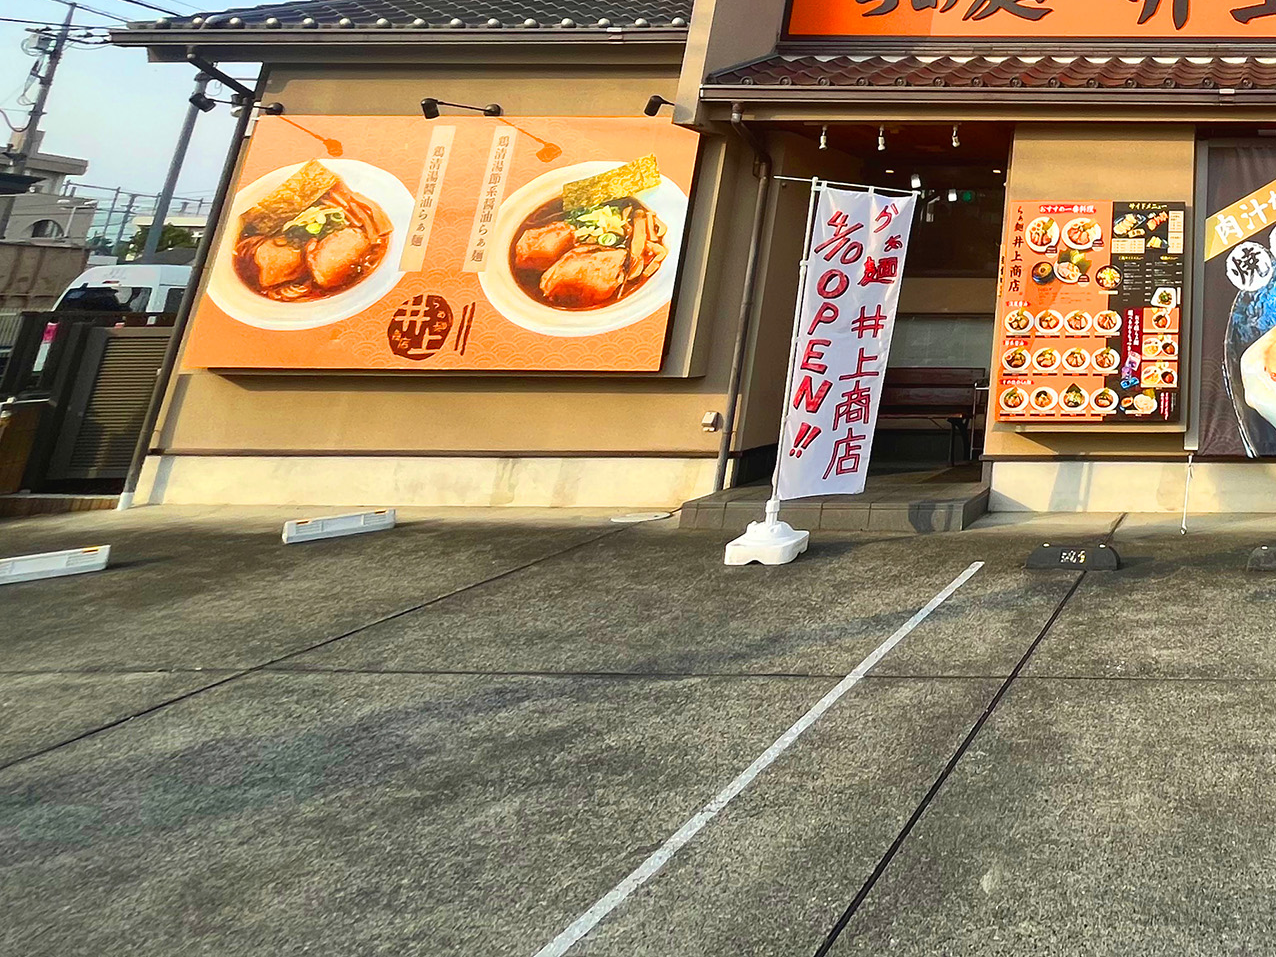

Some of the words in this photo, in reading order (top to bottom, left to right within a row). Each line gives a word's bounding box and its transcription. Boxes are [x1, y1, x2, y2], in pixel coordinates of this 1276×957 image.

[411, 146, 445, 247] 鶏清湯醤油らぁ麺
[471, 135, 510, 263] 鶏清湯節系醤油らぁ麺
[1008, 235, 1024, 292] 井上商店
[822, 304, 887, 480] 井上商店
